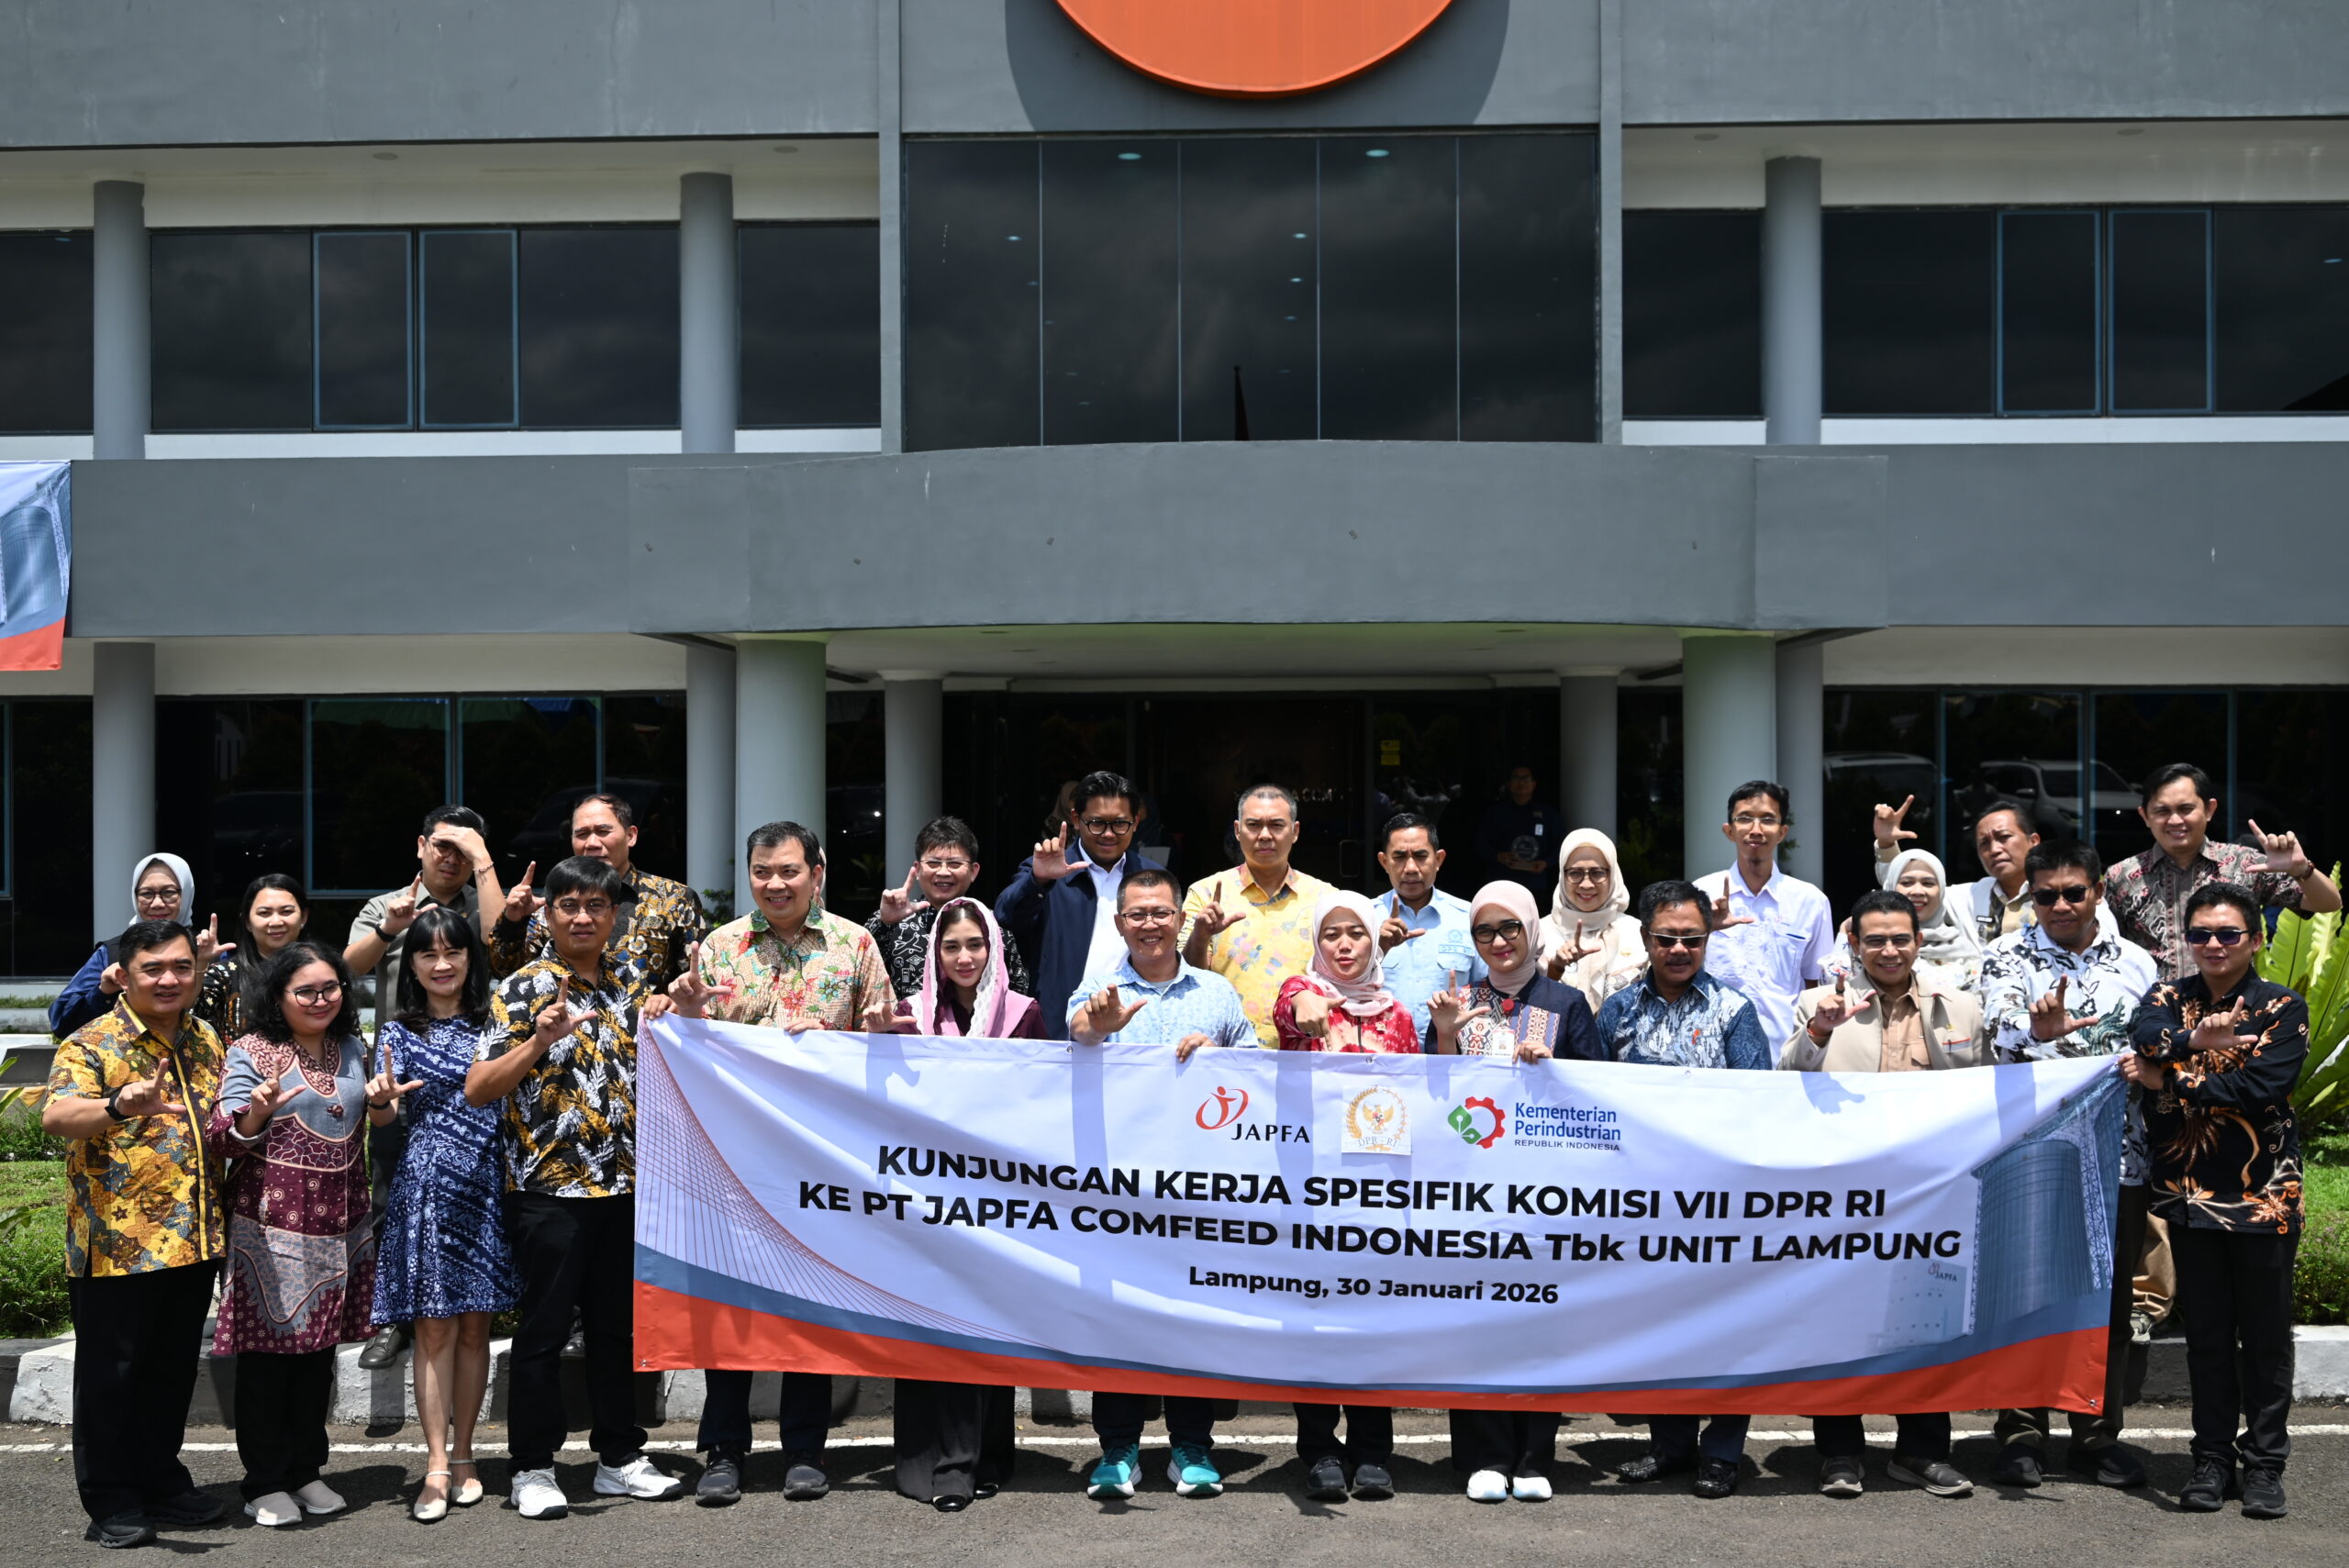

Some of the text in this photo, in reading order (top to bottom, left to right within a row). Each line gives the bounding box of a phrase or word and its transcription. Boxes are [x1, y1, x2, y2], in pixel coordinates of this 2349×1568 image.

[1515, 1102, 1617, 1123] Kementerian
[1230, 1123, 1310, 1143] JAPFA
[1514, 1120, 1621, 1140] Perindustrian
[1358, 1137, 1377, 1146] DPR
[1514, 1139, 1620, 1151] REPUBLIK INDONESIA
[878, 1145, 1886, 1219] KUNJUNGAN KERJA SPESIFIK KOMISI VII DPR RI
[799, 1181, 1962, 1263] KE PT JAPFA COMFEED INDONESIA Tbk UNIT LAMPUNG
[1189, 1266, 1559, 1304] Lampung, 30 Januari 2026
[1934, 1271, 1958, 1283] JAPFA
